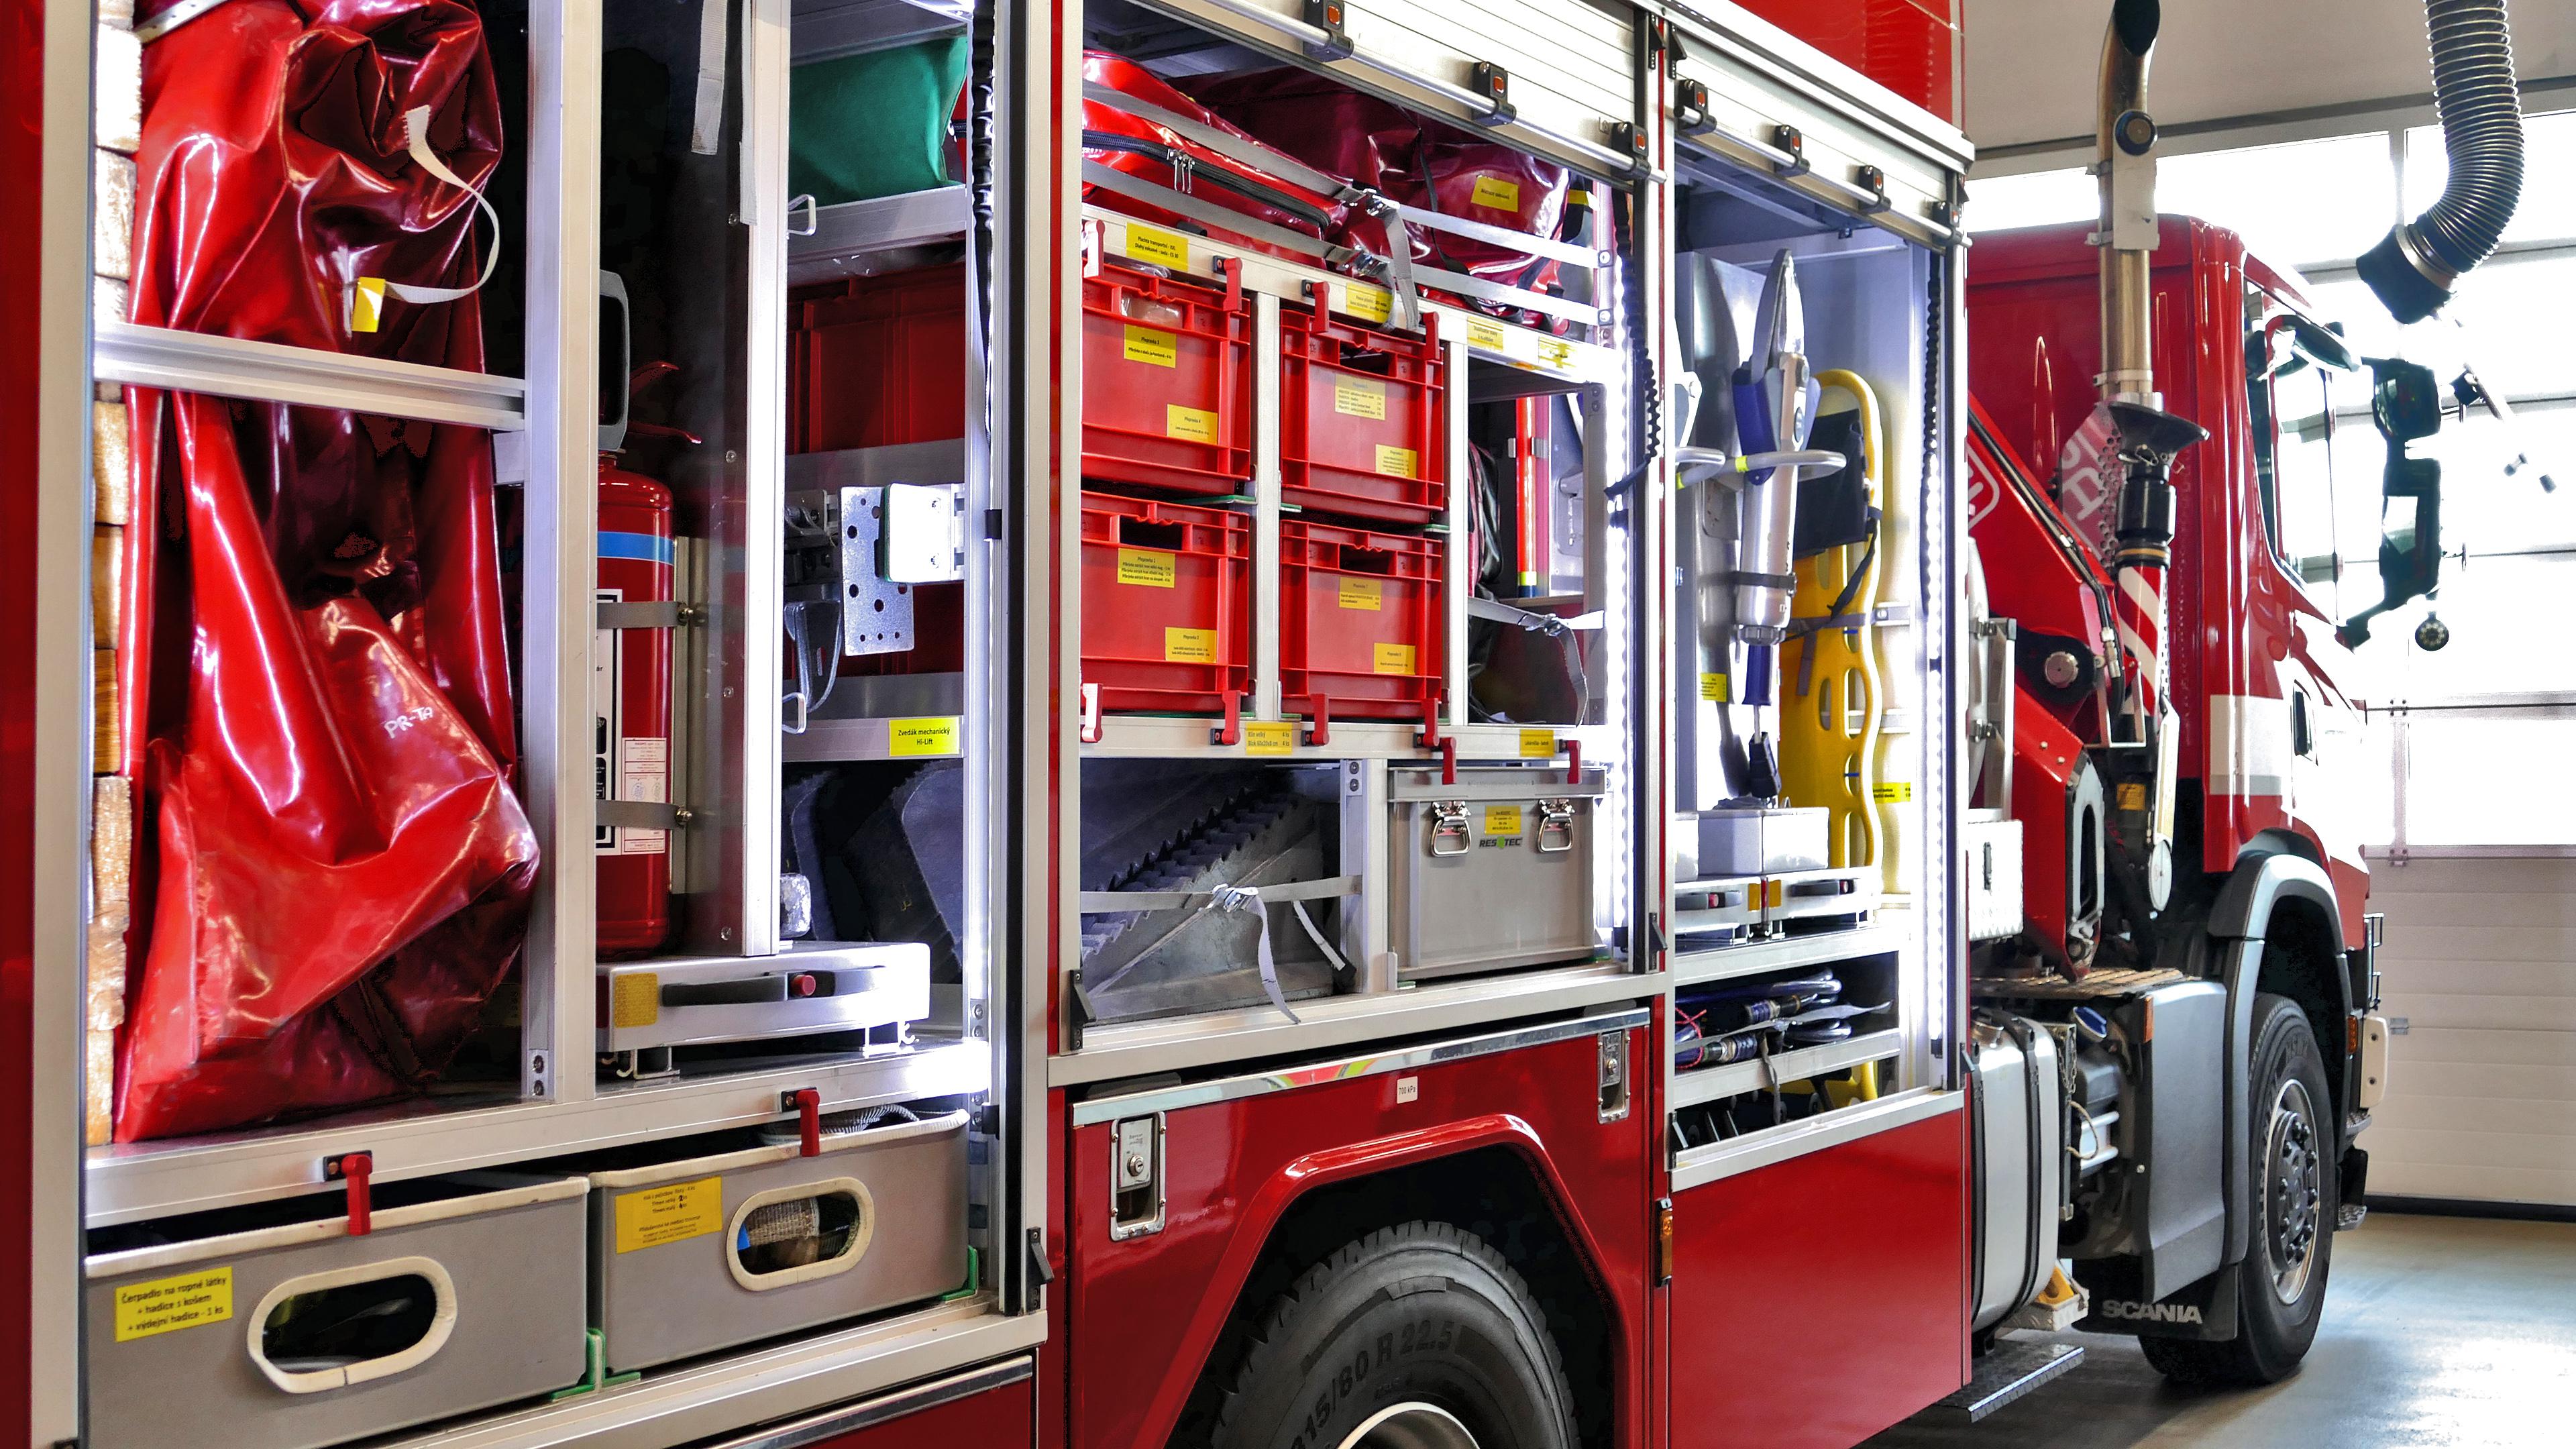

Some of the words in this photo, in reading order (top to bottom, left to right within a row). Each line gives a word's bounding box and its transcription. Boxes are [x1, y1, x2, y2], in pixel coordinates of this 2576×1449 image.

[918, 727, 951, 735] mechanický
[1399, 1087, 1407, 1095] 700
[121, 1289, 162, 1304] Čerpadlo
[178, 1280, 203, 1293] ropné
[206, 1277, 227, 1287] látky
[146, 1301, 174, 1313] hadice
[183, 1294, 212, 1306] košem
[2102, 1299, 2203, 1325] SCANIA
[171, 1310, 199, 1323] hadice
[1377, 1332, 1393, 1368] R
[1399, 1320, 1455, 1356] 22.5
